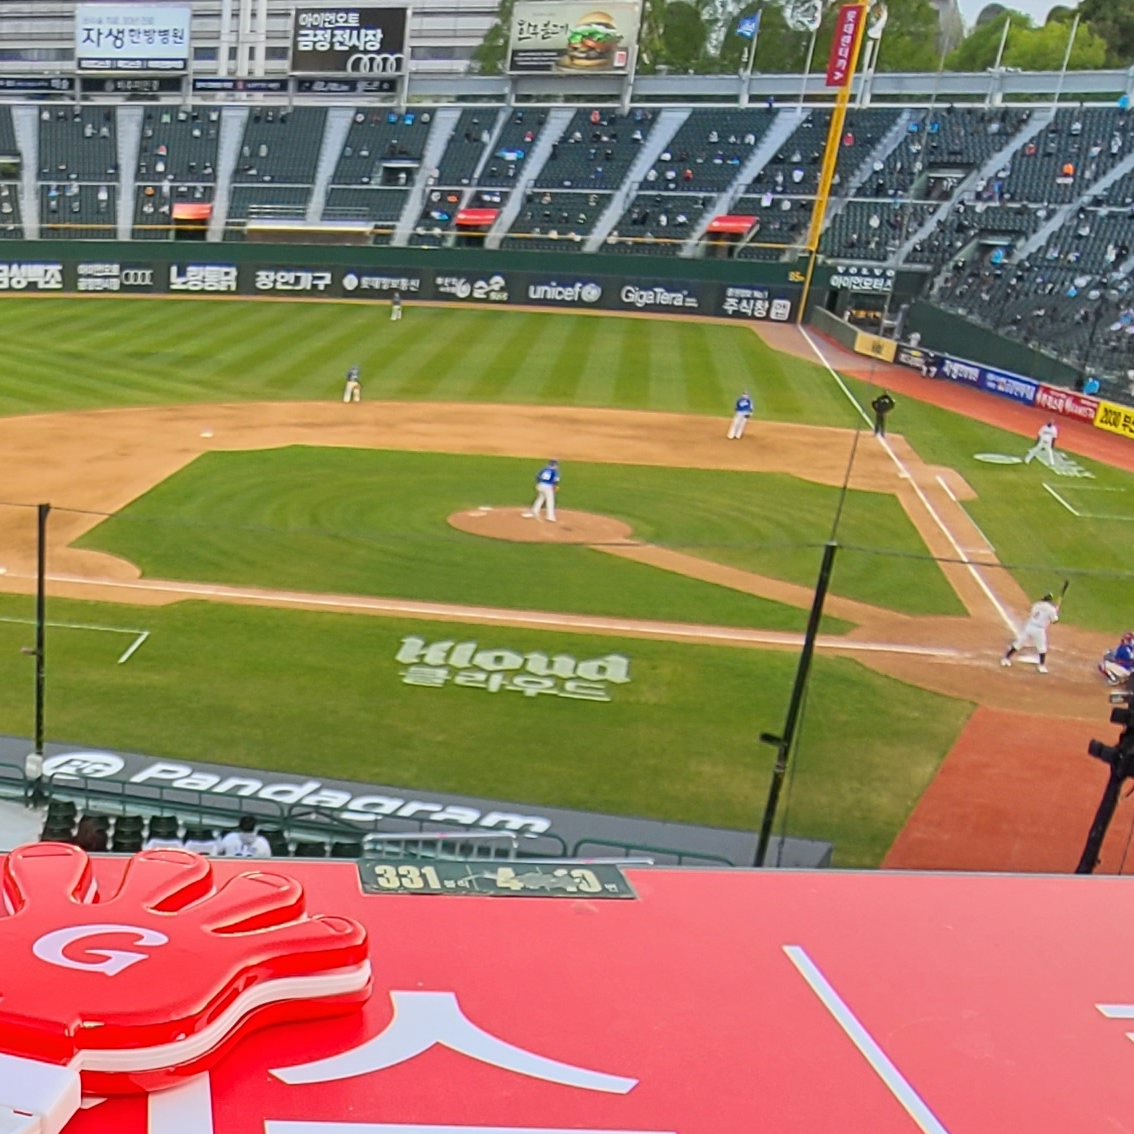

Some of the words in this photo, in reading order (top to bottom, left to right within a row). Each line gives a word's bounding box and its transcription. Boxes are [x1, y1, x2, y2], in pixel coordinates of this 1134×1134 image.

[81, 27, 185, 49] 자생한방병원
[297, 30, 332, 51] 금정
[332, 29, 383, 51] 전시장
[170, 264, 237, 291] 노랑통닭
[255, 270, 332, 291] 장인가구
[837, 266, 895, 277] VOLVO
[528, 281, 582, 302] unicef
[830, 275, 893, 292] 아이언모터스
[620, 285, 685, 308] GigaTera
[395, 636, 631, 684] Kloud
[398, 665, 612, 702] 클라우드
[129, 761, 552, 839] Pandagram
[374, 865, 442, 890] 331
[32, 923, 170, 977] G
